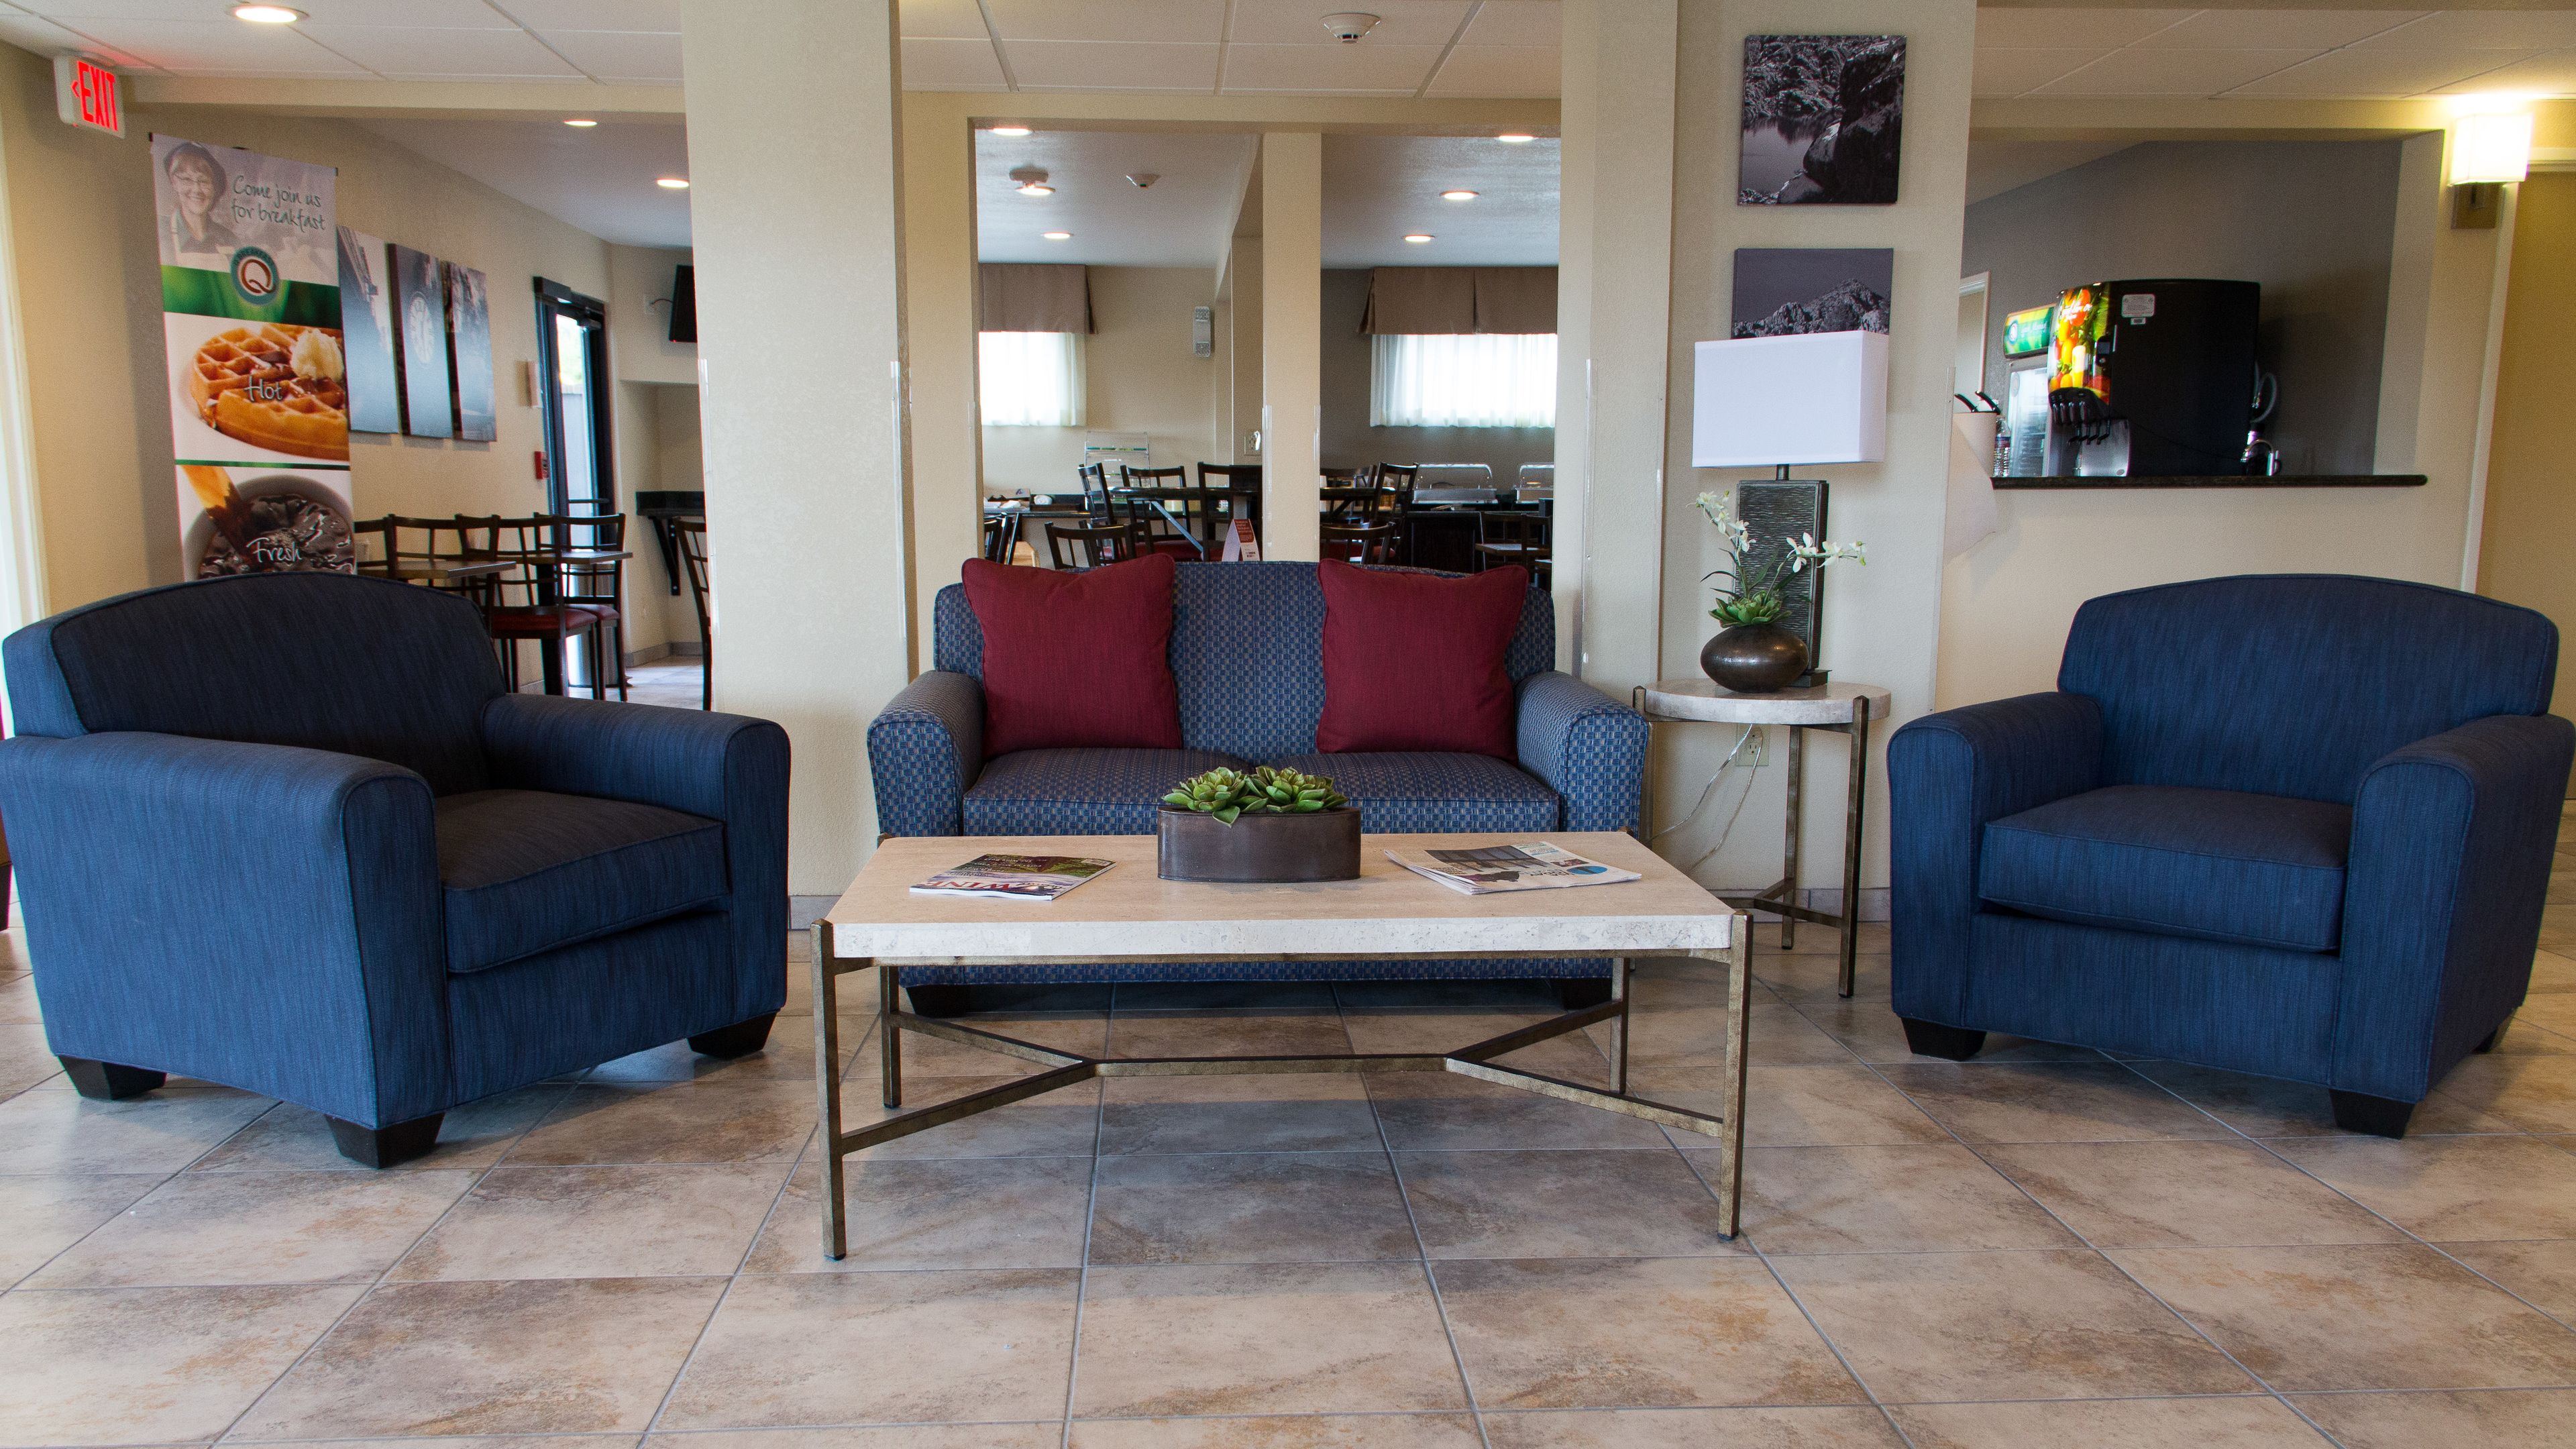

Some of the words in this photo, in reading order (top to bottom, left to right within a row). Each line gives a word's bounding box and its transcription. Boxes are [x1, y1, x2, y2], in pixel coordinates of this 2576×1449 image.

[76, 60, 119, 132] EXIT
[233, 174, 272, 199] Come
[274, 184, 301, 209] join
[305, 193, 321, 208] us
[231, 199, 254, 223] for
[258, 203, 326, 232] breakfast
[240, 258, 276, 294] Q
[244, 375, 282, 402] Hot
[246, 537, 303, 564] Fresh
[924, 880, 1011, 892] WINE
